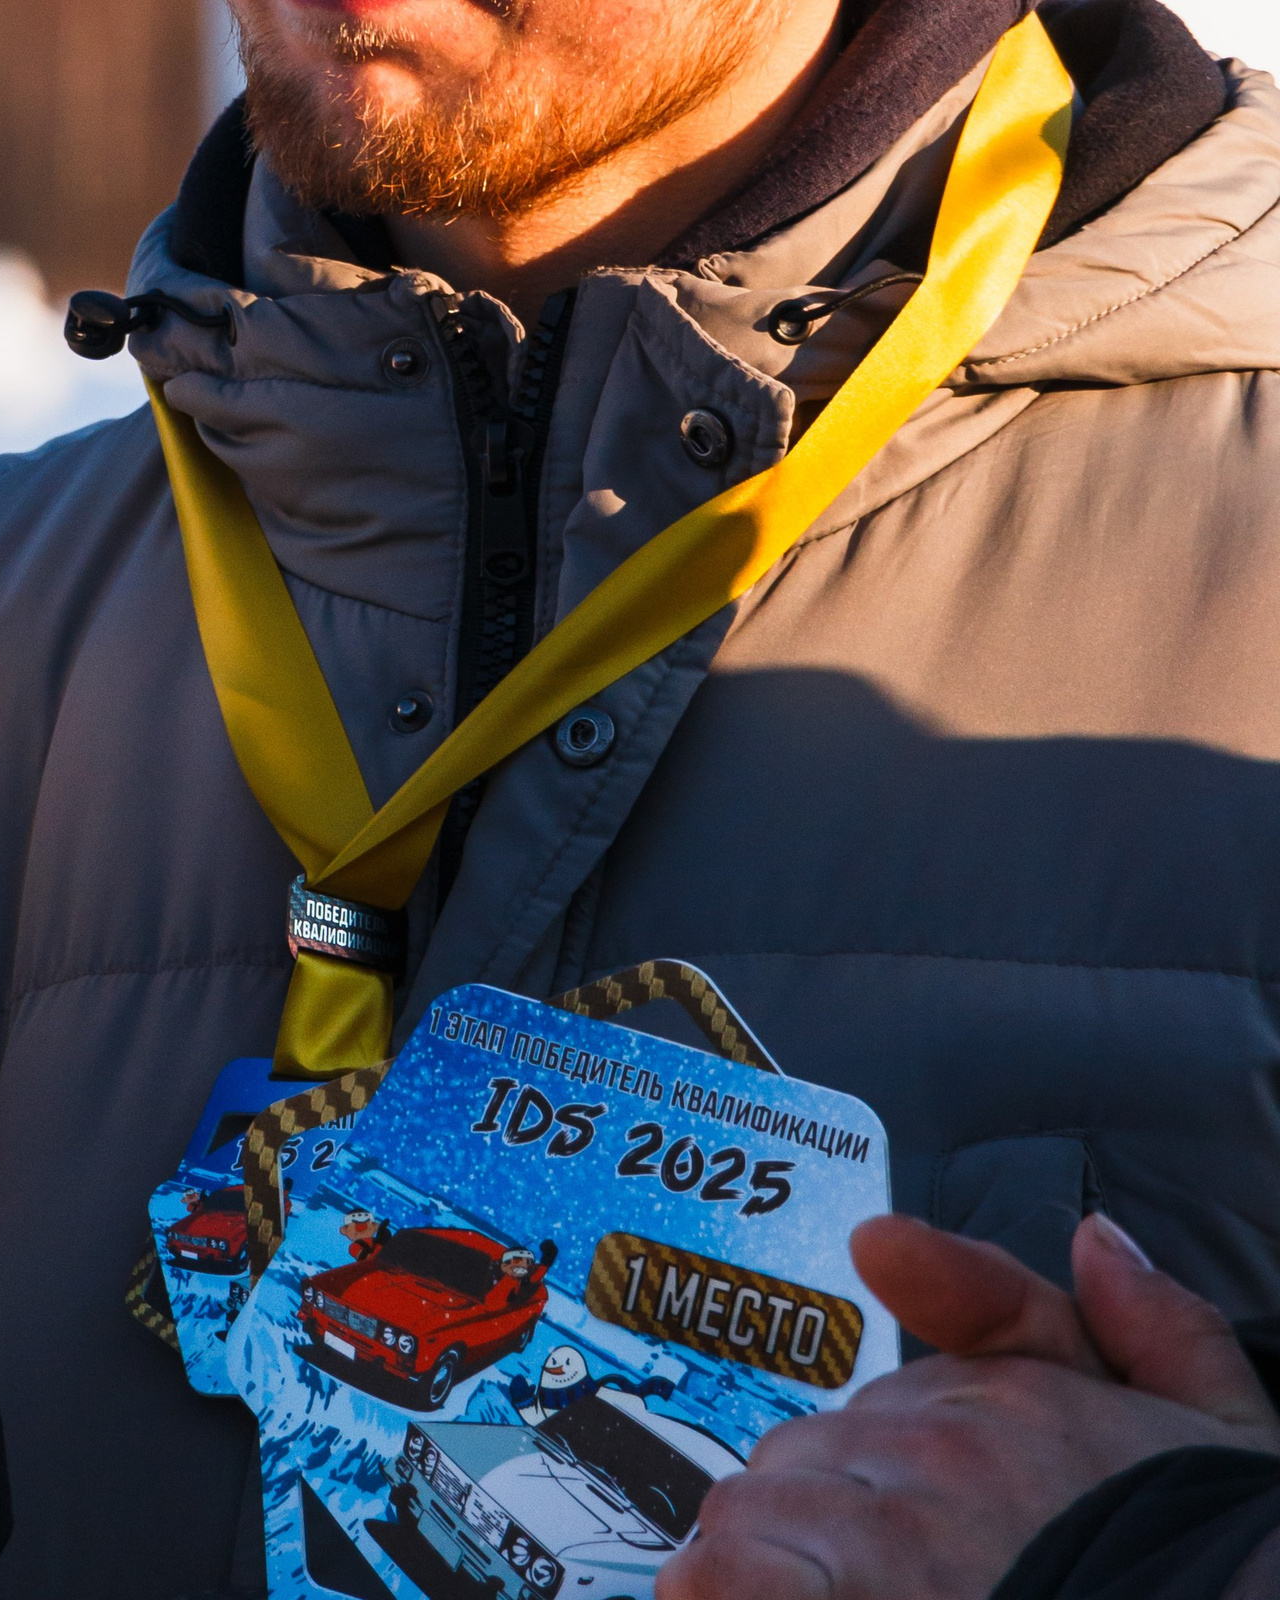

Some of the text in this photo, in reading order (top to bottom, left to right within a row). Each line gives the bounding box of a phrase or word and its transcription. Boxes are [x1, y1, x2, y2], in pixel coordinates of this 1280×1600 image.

[429, 1006, 870, 1164] 1 ЭТАП ПОБЕДИТЕЛЬ КВАЛИФИКАЦИИ
[471, 1077, 797, 1218] IDS 2025
[624, 1255, 826, 1366] 1 МЕСТО
